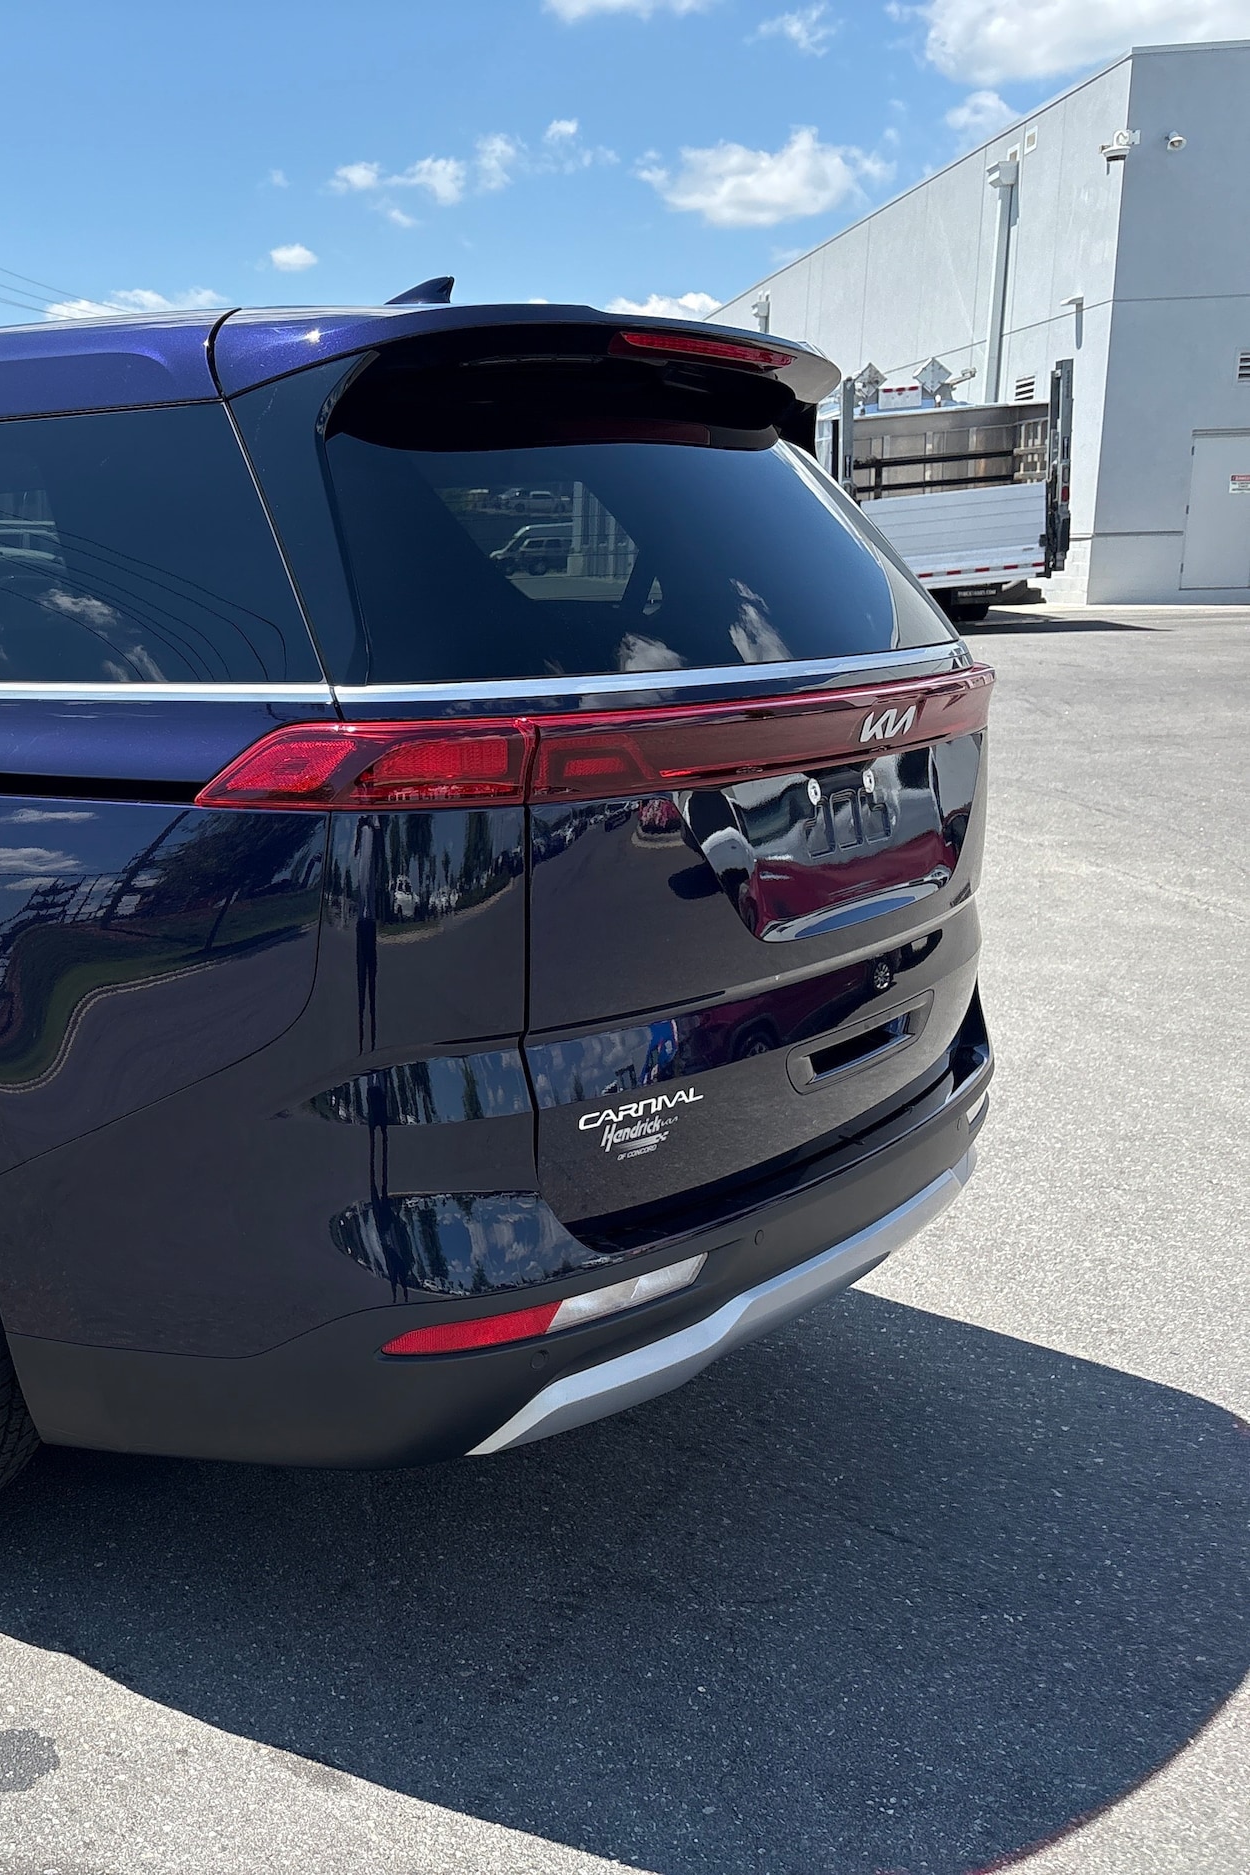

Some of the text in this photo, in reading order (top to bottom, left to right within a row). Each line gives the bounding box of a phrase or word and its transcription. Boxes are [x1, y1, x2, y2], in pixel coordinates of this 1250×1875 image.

[859, 704, 918, 743] KIA
[578, 1086, 704, 1130] CARNIVAL
[600, 1115, 662, 1152] Hendrick
[627, 1144, 658, 1159] CONCORD
